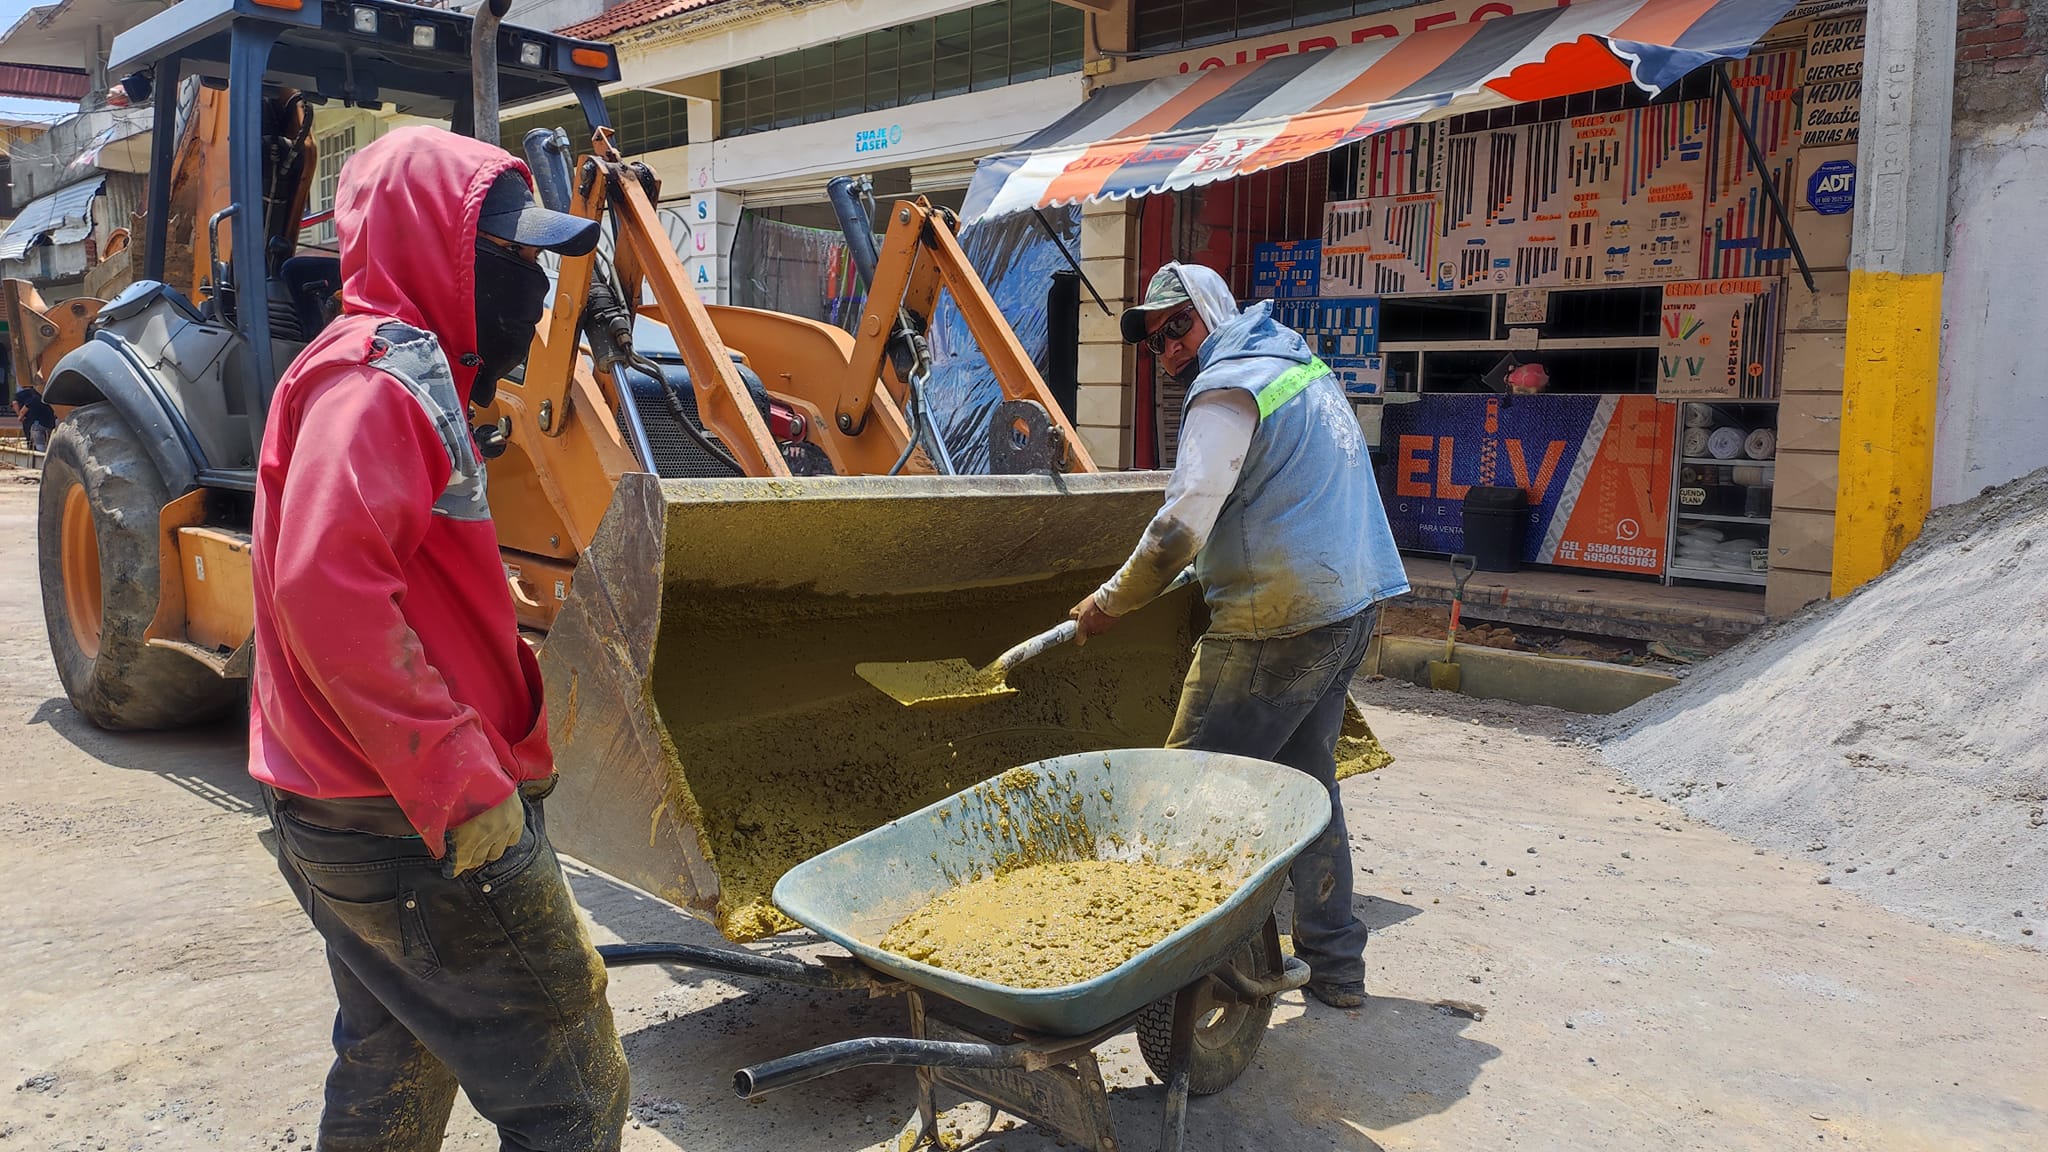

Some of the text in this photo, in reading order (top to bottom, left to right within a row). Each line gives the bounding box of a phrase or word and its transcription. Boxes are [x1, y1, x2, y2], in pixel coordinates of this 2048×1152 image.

[1813, 18, 1863, 38] VENTA
[1806, 61, 1863, 81] CIERRES
[856, 128, 887, 141] SUAJE
[1804, 129, 1843, 144] VARIAS
[856, 139, 888, 152] LASER
[1816, 173, 1855, 193] ADT
[1276, 301, 1320, 310] ELASTICOS
[1419, 523, 1438, 532] PARA
[1587, 543, 1657, 557] 5584145621
[1584, 551, 1657, 568] 5959539183
